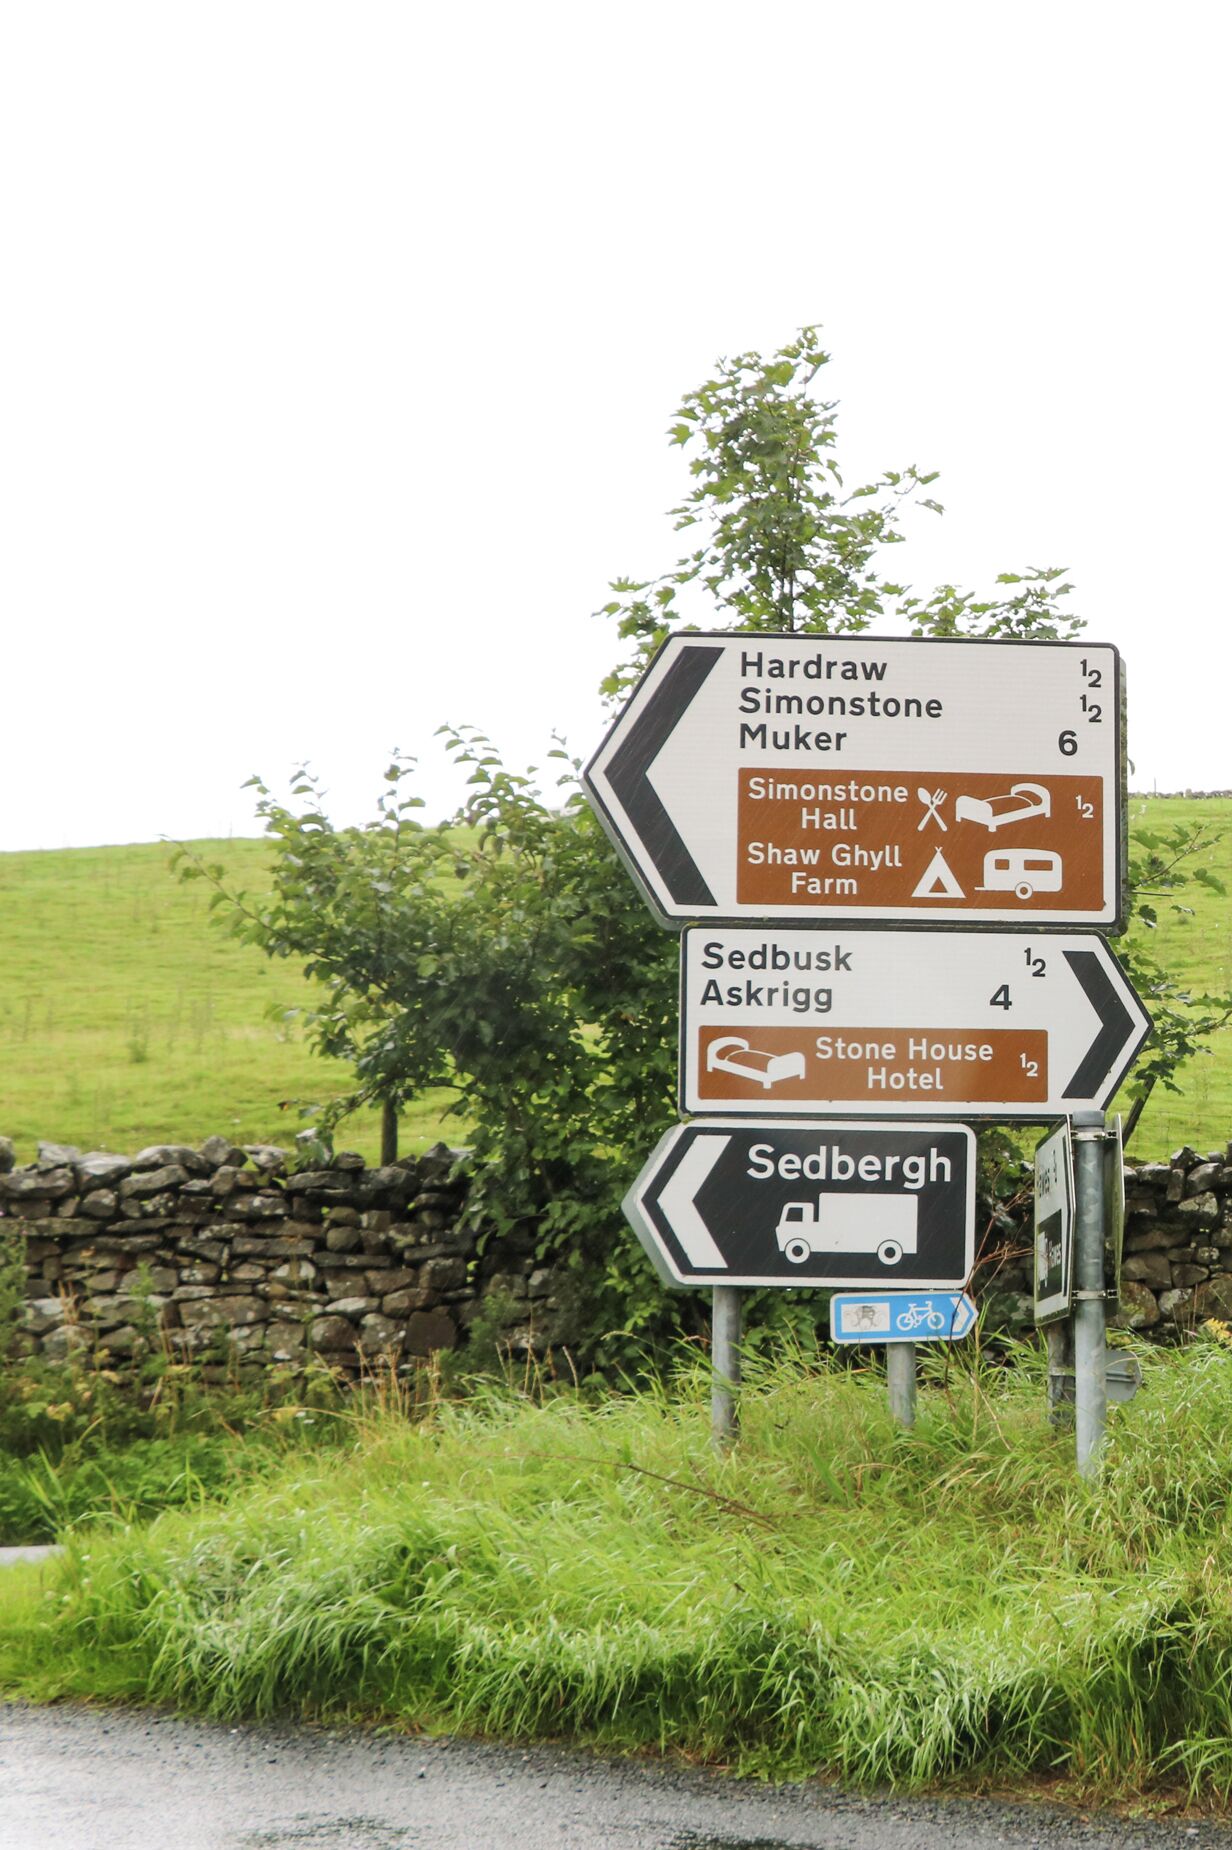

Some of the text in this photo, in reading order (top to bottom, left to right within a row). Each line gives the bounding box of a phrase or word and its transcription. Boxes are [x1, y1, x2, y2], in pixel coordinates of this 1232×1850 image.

[741, 651, 888, 681] Hardraw
[738, 686, 943, 719] Simonstone
[739, 723, 1078, 757] Muker 6
[748, 777, 909, 803] Simonstone
[801, 807, 858, 831] Hall
[747, 841, 903, 871] Shaw Ghyll
[791, 871, 858, 895] Farm
[701, 941, 853, 972] Sedbusk
[700, 979, 1013, 1014] Askrigg 4
[815, 1036, 994, 1061] Stone House
[867, 1066, 944, 1090] Hotel
[746, 1143, 952, 1190] Sedbergh
